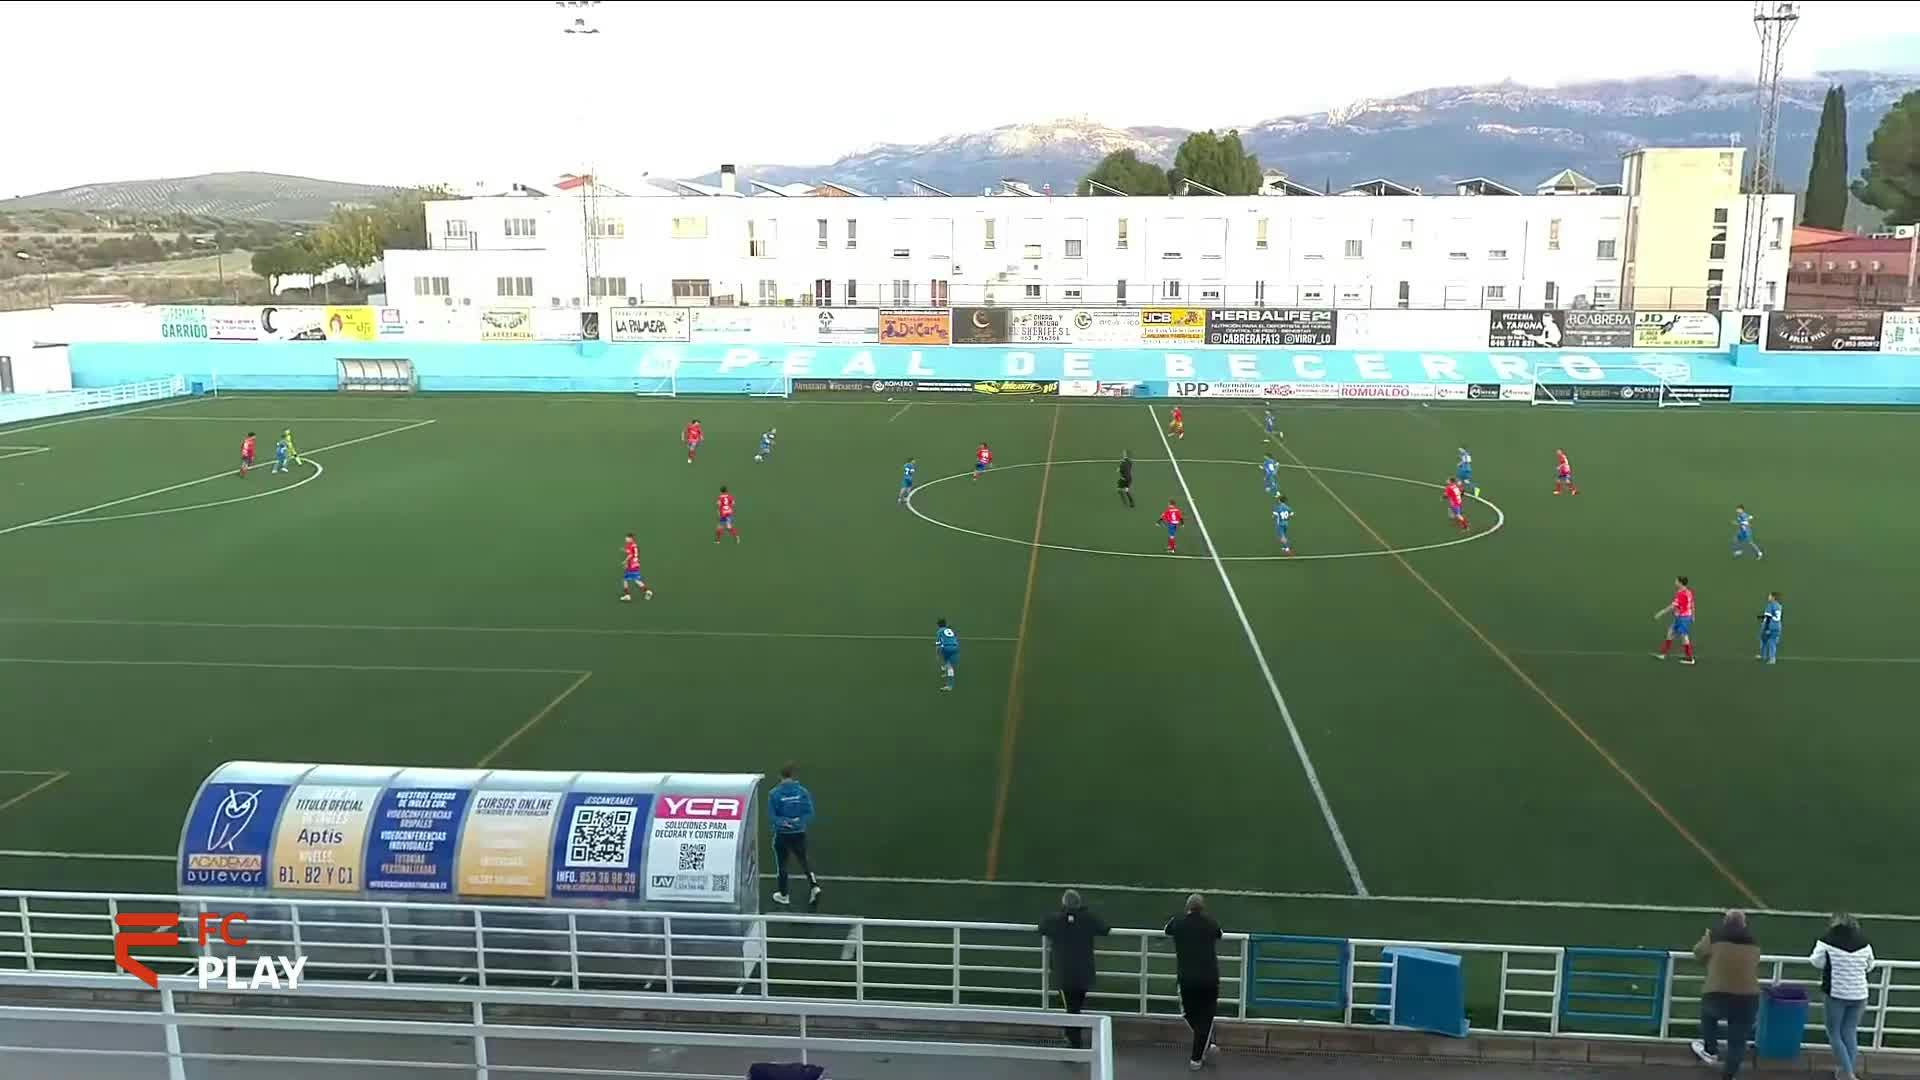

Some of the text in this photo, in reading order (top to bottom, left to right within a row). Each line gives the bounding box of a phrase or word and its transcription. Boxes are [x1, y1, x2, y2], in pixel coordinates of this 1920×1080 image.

[1143, 312, 1171, 322] JCB
[1639, 313, 1663, 322] JD
[161, 323, 208, 338] GARRIDO
[614, 320, 627, 333] LA
[629, 320, 668, 333] PALMERA
[1491, 321, 1503, 329] LA
[1222, 333, 1281, 345] CABRERAFA13
[718, 348, 1606, 381] PEAL DE BECERRO
[1341, 387, 1410, 397] ROMUALDO
[328, 800, 363, 812] OFICIAL
[476, 797, 553, 810] CURSOS ONLINE
[665, 821, 727, 830] SOLUCIONES PARA
[297, 828, 344, 846] Aptis
[655, 829, 690, 839] DECORAR
[695, 830, 735, 840] CONSTRUIR
[190, 855, 261, 868] ACADEMIA
[304, 866, 321, 884] B2
[327, 866, 335, 884] Y
[338, 866, 353, 884] C1
